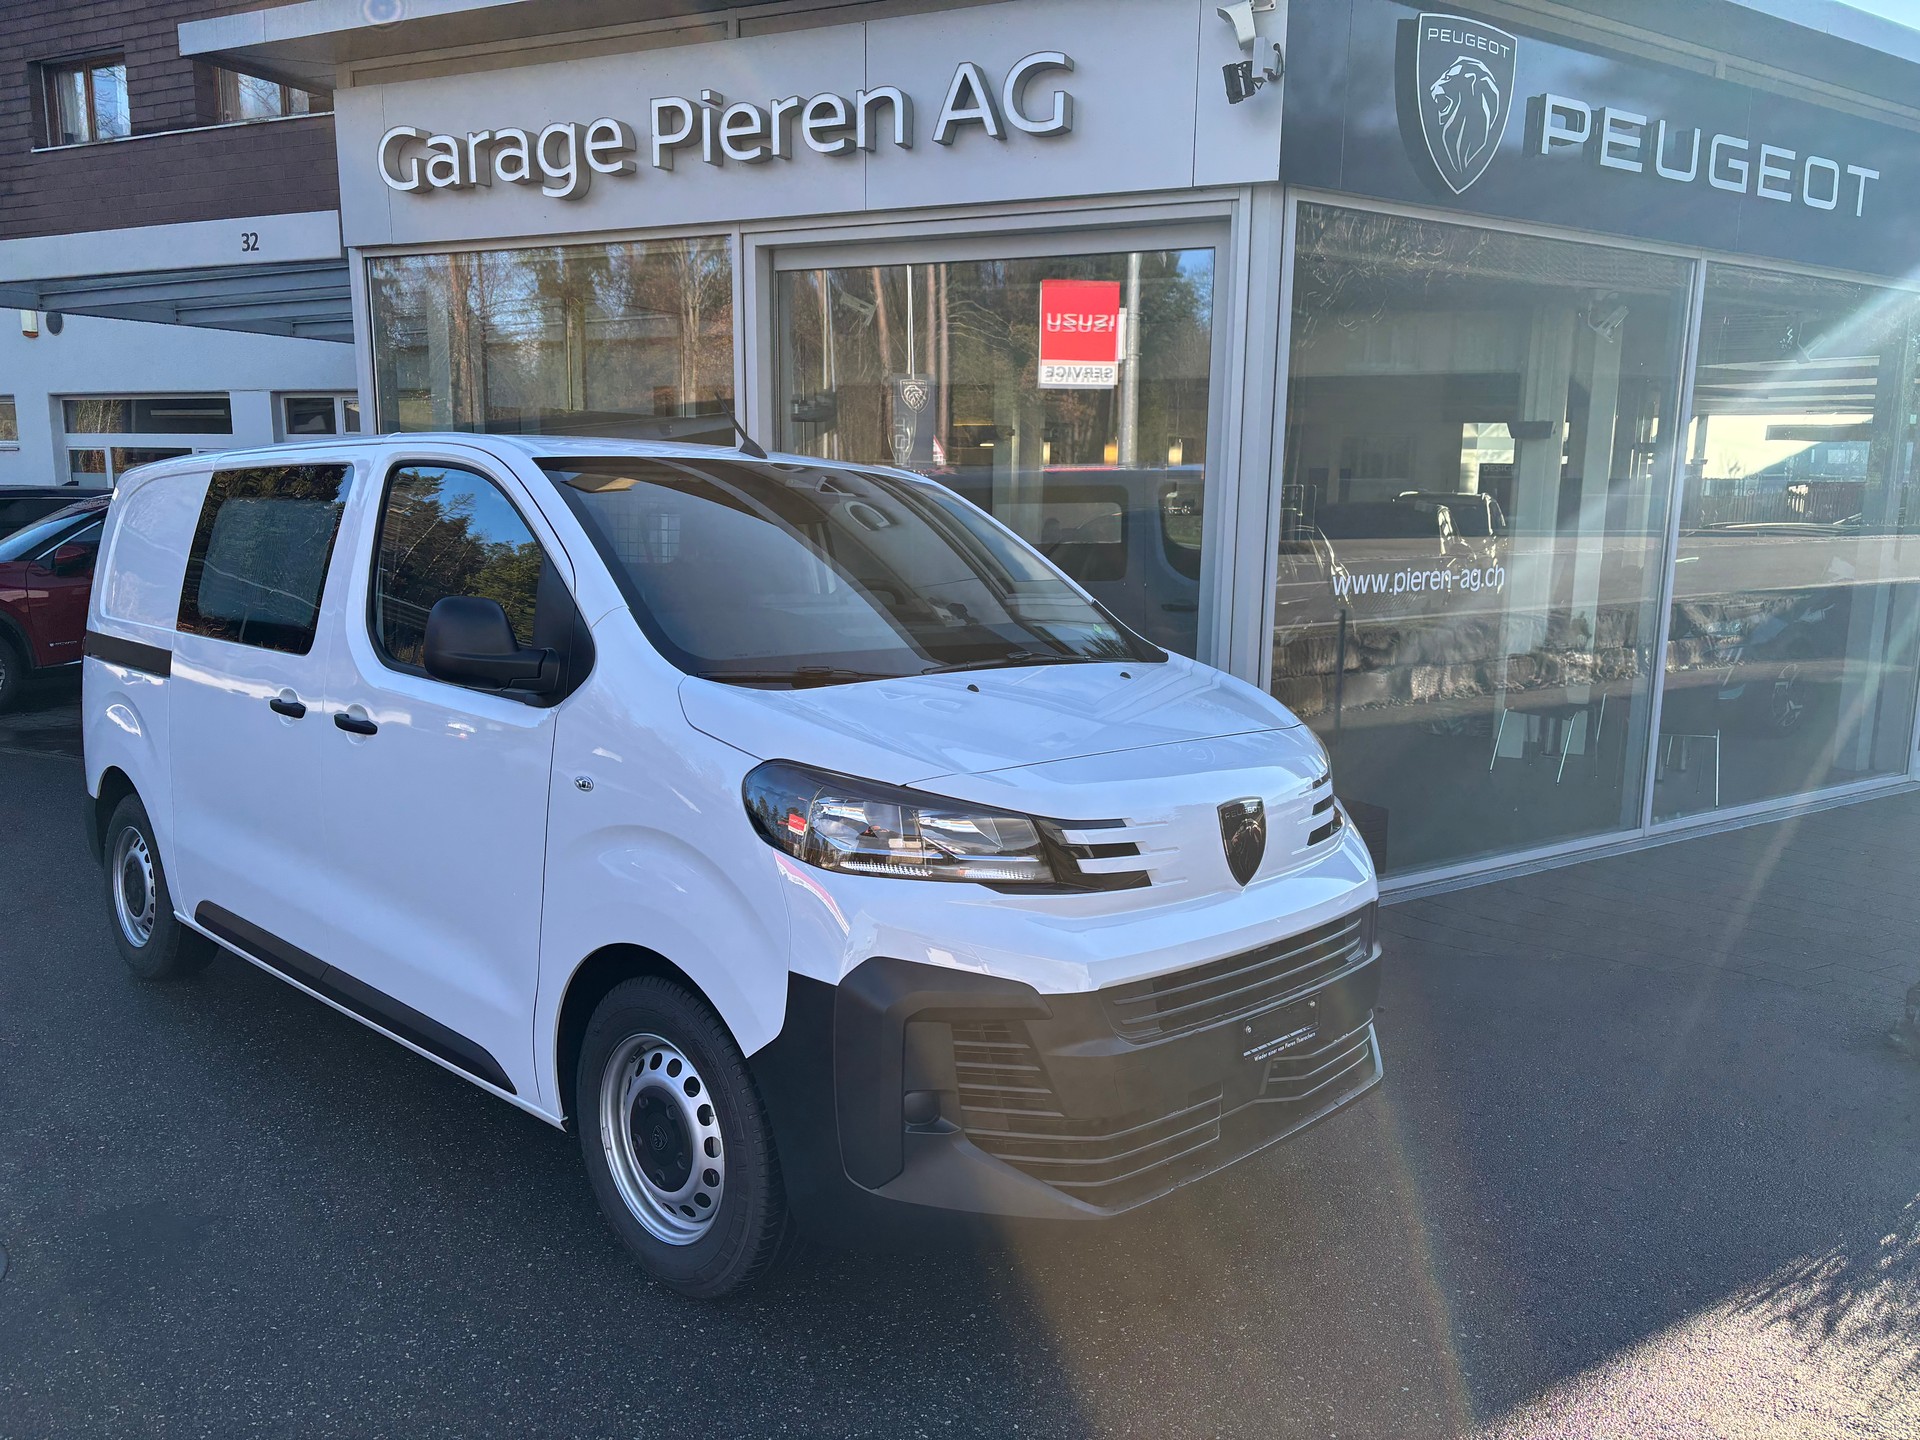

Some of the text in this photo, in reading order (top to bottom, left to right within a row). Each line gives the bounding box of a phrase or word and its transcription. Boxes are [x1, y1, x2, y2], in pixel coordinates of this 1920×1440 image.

[1428, 28, 1510, 58] PEUGEOT
[377, 51, 1074, 200] Garage Pieren AG
[1541, 93, 1880, 217] PEUGEOT
[241, 232, 260, 252] 32
[1333, 565, 1505, 596] www.pieren-ag.ch
[1225, 806, 1261, 820] PEUGEOT
